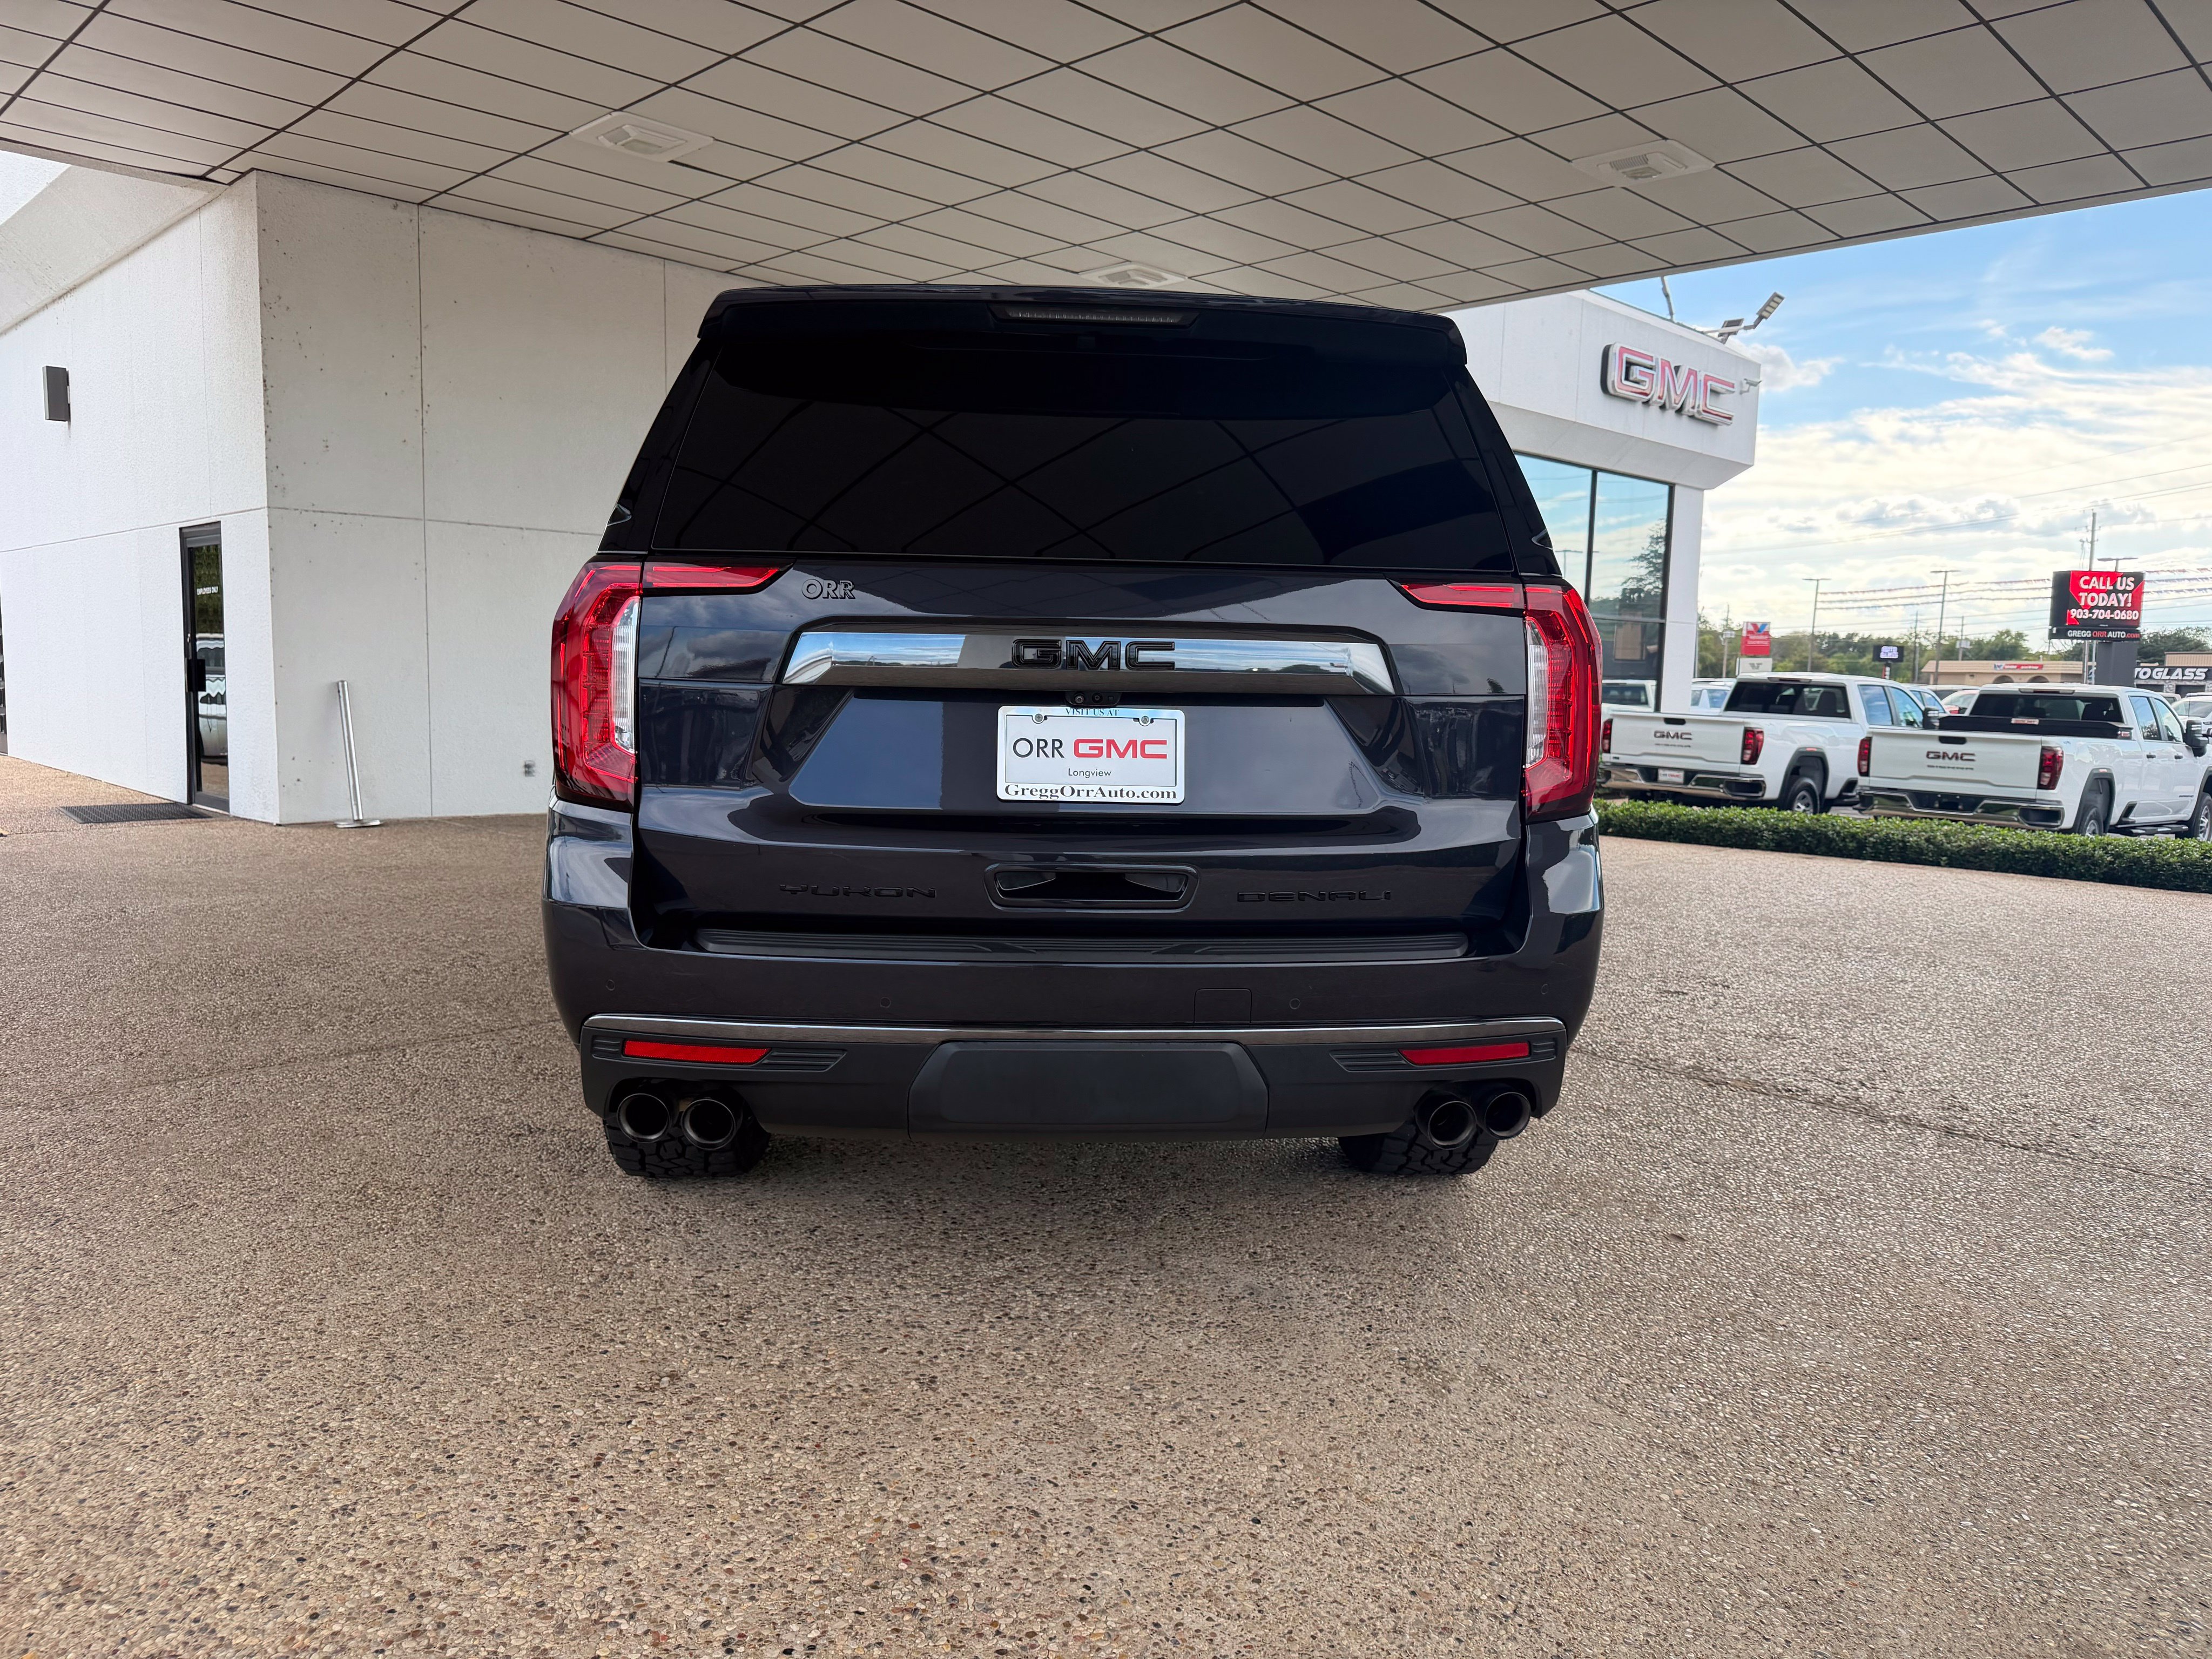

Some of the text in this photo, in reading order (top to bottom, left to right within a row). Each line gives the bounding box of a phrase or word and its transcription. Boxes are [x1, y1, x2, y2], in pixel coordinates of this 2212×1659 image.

[1601, 341, 1736, 426] GMC
[801, 578, 855, 599] ORR
[2080, 576, 2135, 590] CALL US
[2079, 592, 2133, 607] TODAY!
[2071, 609, 2139, 620] 903-704-0680
[1011, 639, 1175, 671] GMC
[2153, 668, 2208, 680] GLASS
[1065, 707, 1090, 716] VISIT
[1654, 731, 1692, 740] GMC
[1013, 738, 1167, 759] ORR GMC
[1926, 751, 1976, 761] GMC
[1068, 768, 1112, 778] Longview
[1004, 784, 1177, 799] GreggOrrAuto.com
[780, 884, 936, 898] YUKON
[1237, 889, 1392, 902] DENALI
